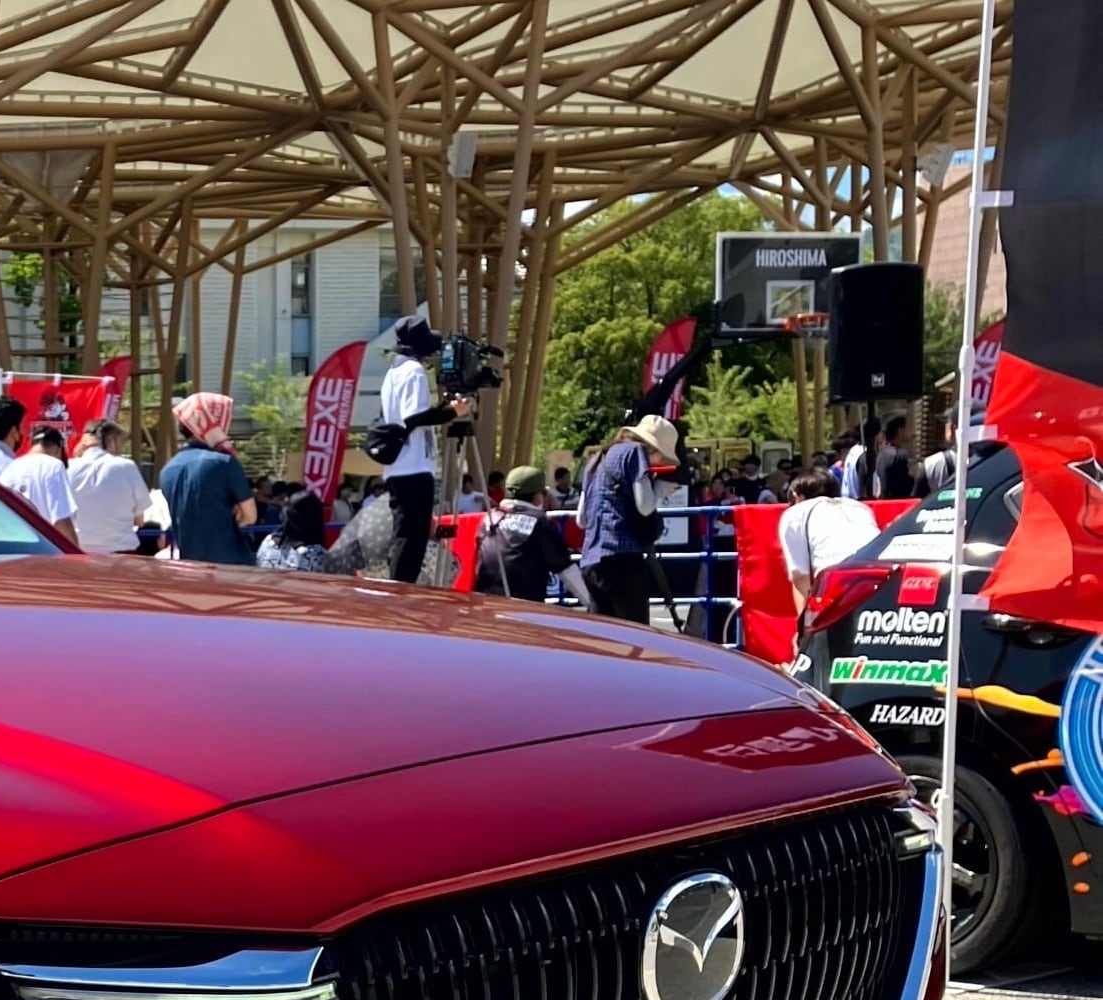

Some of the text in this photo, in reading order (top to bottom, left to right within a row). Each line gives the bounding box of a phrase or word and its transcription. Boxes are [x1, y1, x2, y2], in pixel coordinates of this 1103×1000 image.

[755, 248, 827, 267] HIROSHIMA
[858, 607, 945, 632] molten
[854, 632, 944, 647] Fun and Functional
[869, 704, 945, 726] HAZARD
